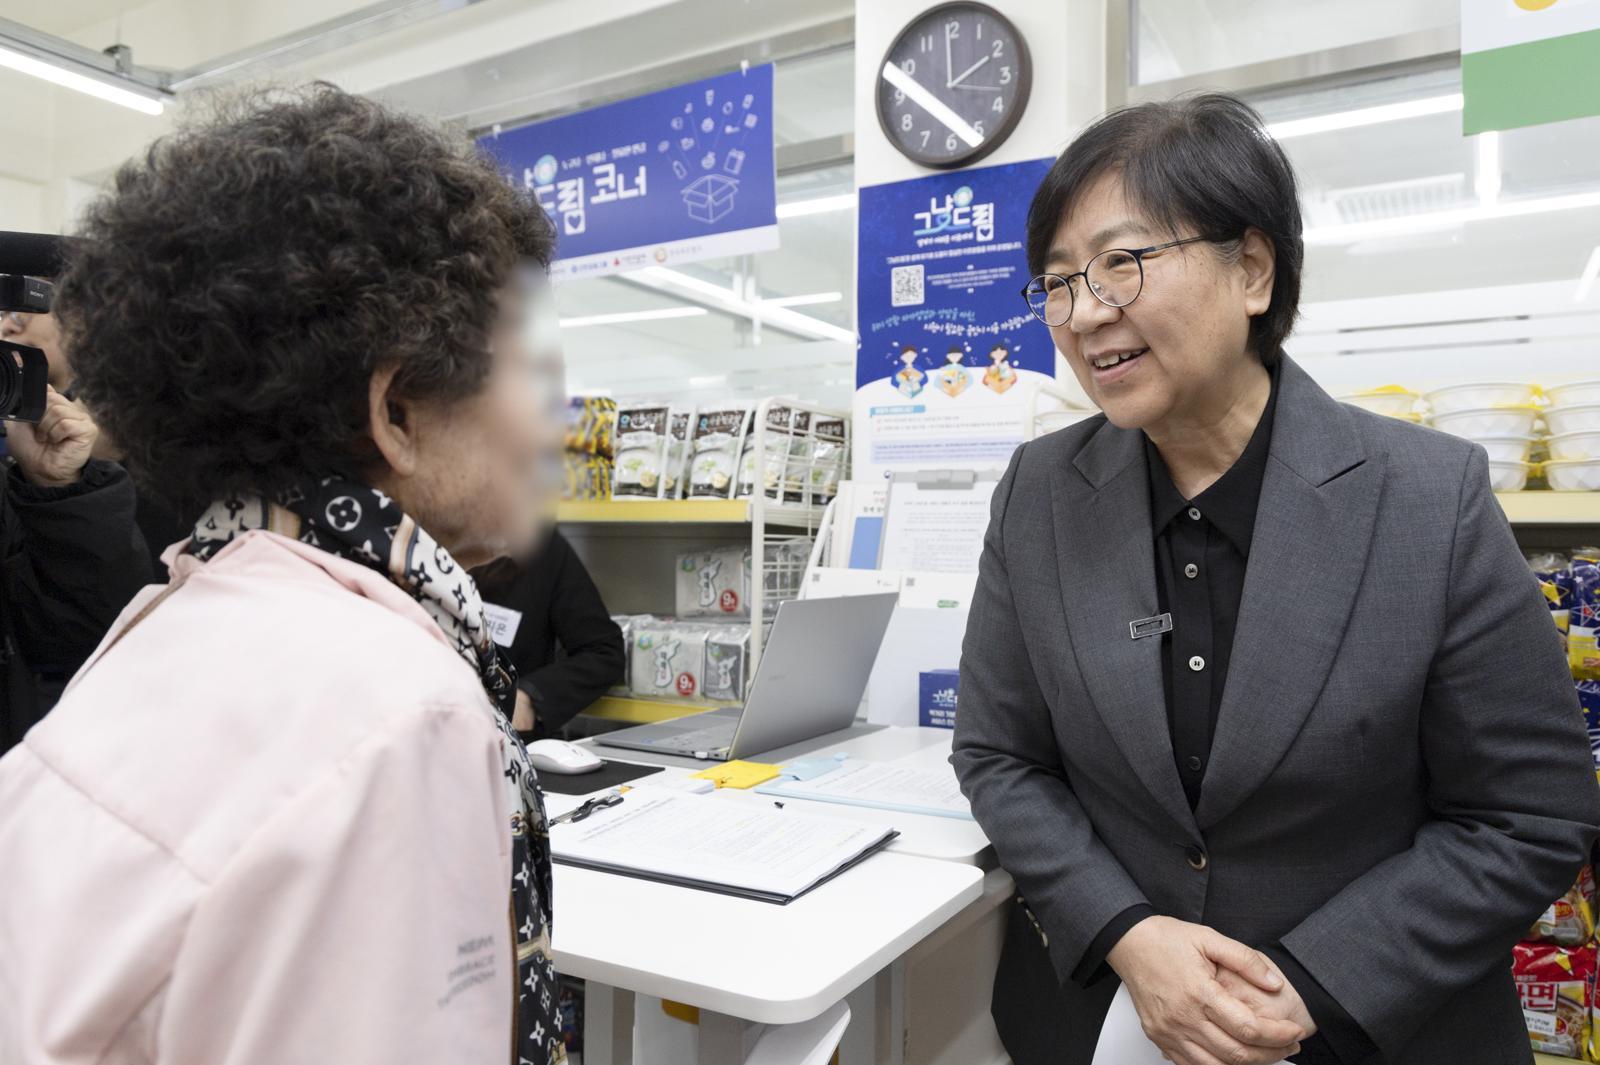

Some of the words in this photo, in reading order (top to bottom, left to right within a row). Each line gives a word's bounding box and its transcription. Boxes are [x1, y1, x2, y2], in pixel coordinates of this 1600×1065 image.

[975, 23, 982, 41] 1
[920, 35, 933, 53] 11
[992, 40, 1003, 58] 2
[1000, 66, 1011, 84] 3
[992, 96, 1004, 112] 4
[901, 114, 913, 132] 8
[920, 130, 931, 147] 7
[945, 134, 957, 150] 6
[590, 163, 647, 204] 코너
[913, 186, 995, 242] 그냥드림
[932, 688, 958, 704] 그냥드
